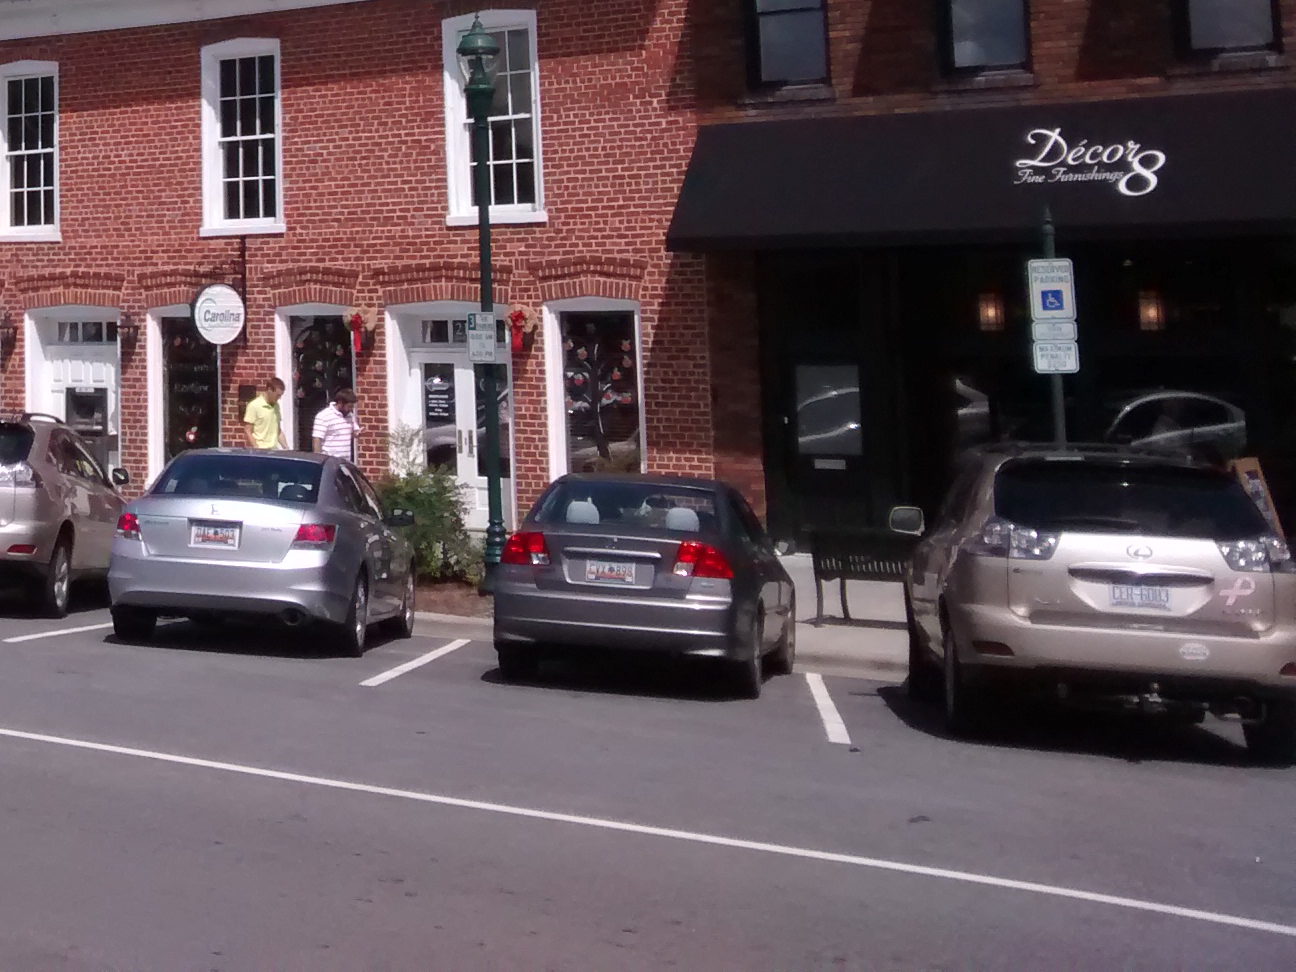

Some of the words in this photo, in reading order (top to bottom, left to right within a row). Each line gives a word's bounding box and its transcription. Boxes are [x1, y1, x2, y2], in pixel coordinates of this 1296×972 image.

[1015, 127, 1141, 167] Décor
[1118, 149, 1166, 196] 8
[1014, 168, 1046, 184] Fine
[1048, 166, 1125, 183] Furnishings
[204, 309, 241, 322] Carolina
